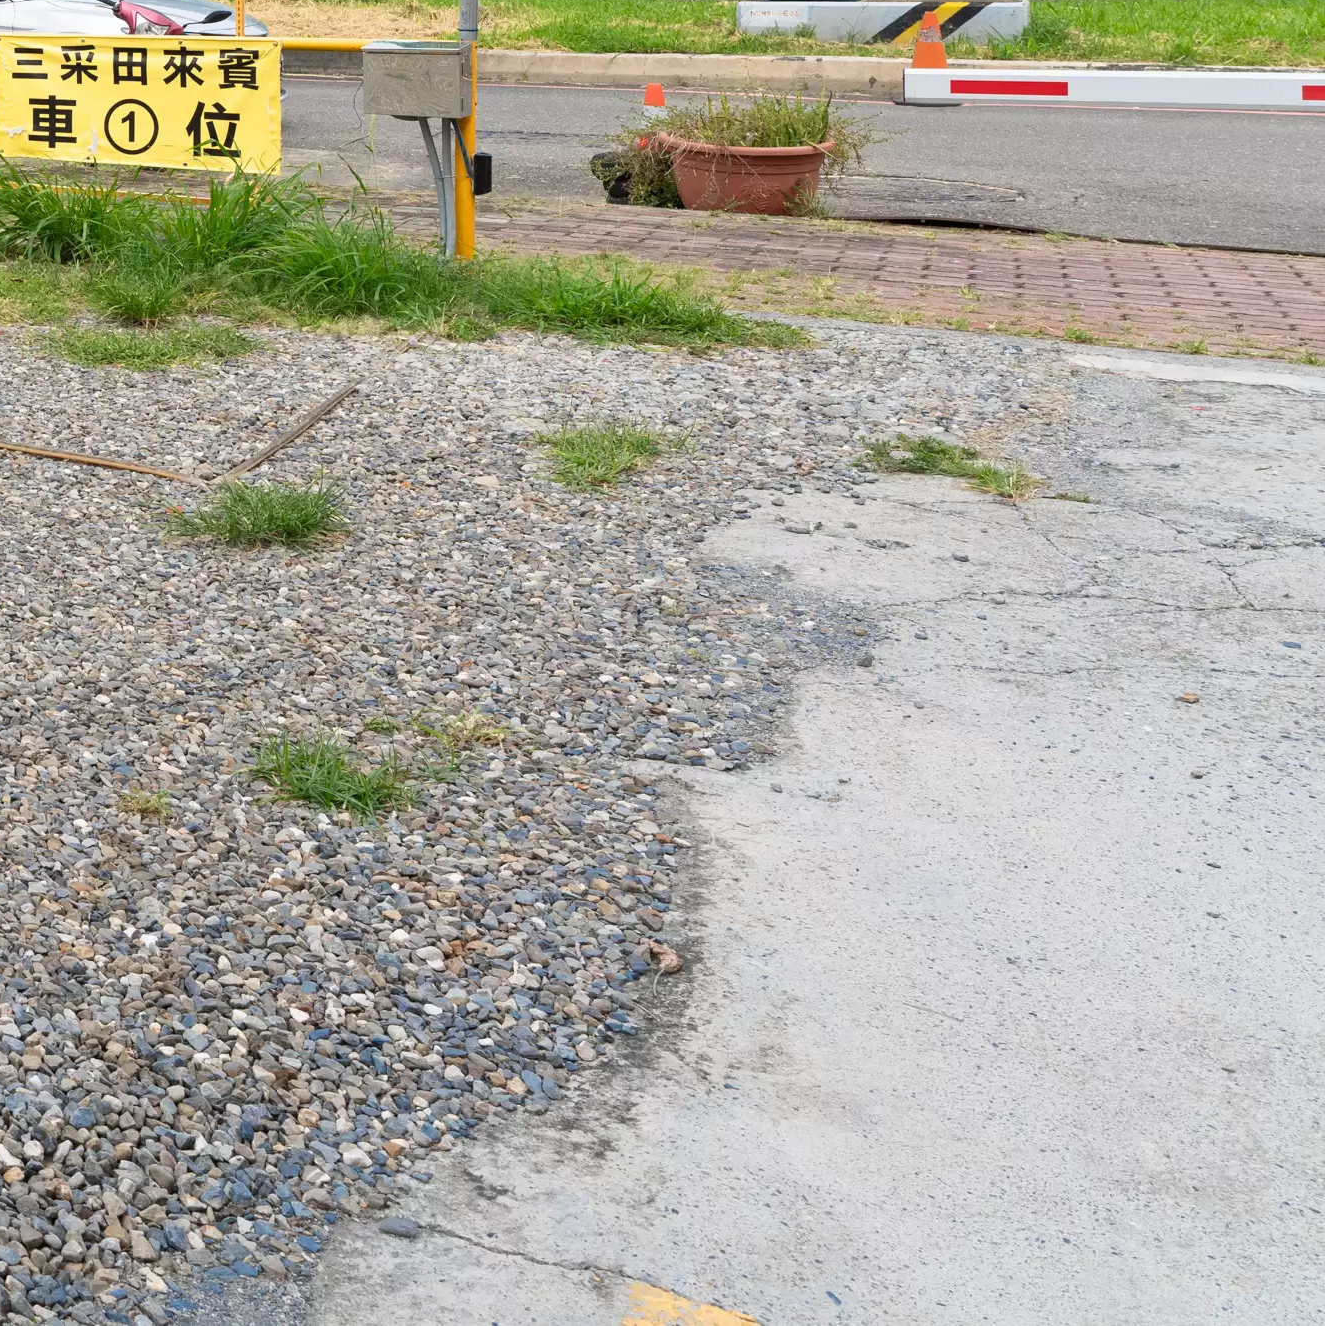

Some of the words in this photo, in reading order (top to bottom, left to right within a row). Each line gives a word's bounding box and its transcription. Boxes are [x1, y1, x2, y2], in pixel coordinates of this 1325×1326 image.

[11, 43, 260, 91] 三采田來賓
